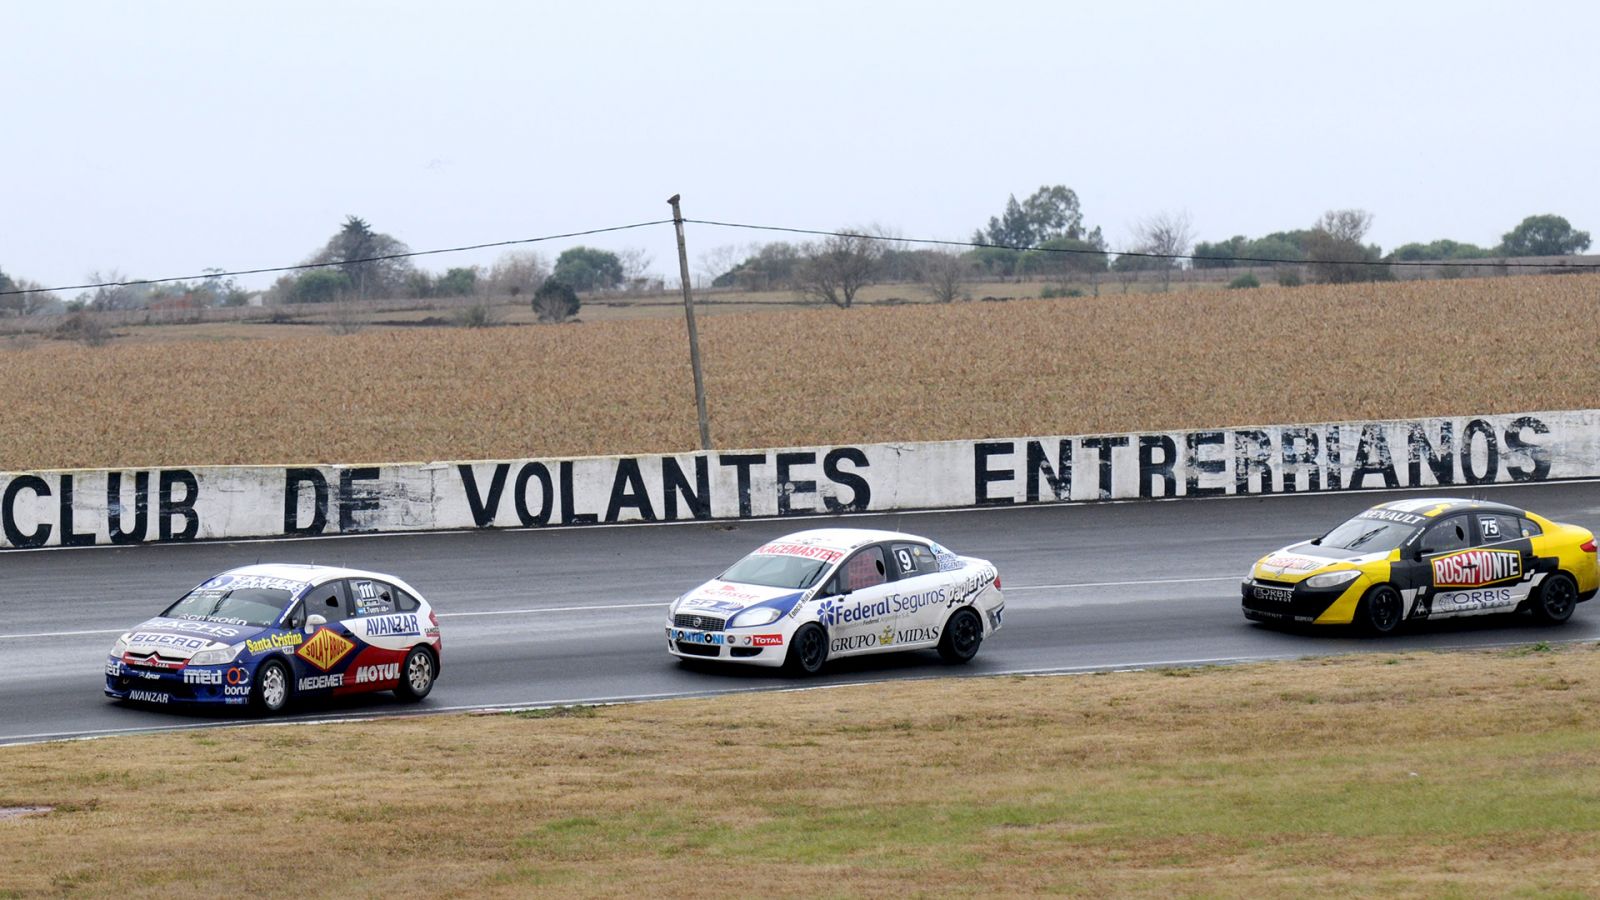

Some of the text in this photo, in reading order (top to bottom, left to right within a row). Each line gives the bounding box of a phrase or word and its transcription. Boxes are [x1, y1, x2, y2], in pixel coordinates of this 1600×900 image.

[2, 416, 1552, 547] CLUB DE VOLANTES ENTRERRIANOS
[1359, 510, 1426, 525] RENAULT
[1481, 519, 1498, 535] 75
[755, 544, 844, 564] RACEMASTER
[898, 549, 912, 570] 9
[1434, 551, 1519, 583] ROSAMONTE
[359, 584, 376, 599] 111
[1261, 588, 1293, 599] ORBIS
[1453, 589, 1511, 605] ORBIS
[835, 598, 890, 625] Federal
[893, 588, 946, 613] Seguros
[366, 614, 419, 635] AVANZAR
[131, 632, 204, 649] BOERO
[246, 637, 272, 653] Santa
[271, 631, 303, 647] Cristina
[671, 628, 725, 645] MONTIRONI
[830, 625, 940, 652] GRUPO MIDAS
[306, 637, 323, 662] SOLA
[183, 669, 222, 684] med
[355, 662, 400, 683] MOTUL
[224, 685, 251, 695] borur
[298, 673, 344, 691] MEDEMET
[129, 690, 169, 703] AVANZAR
